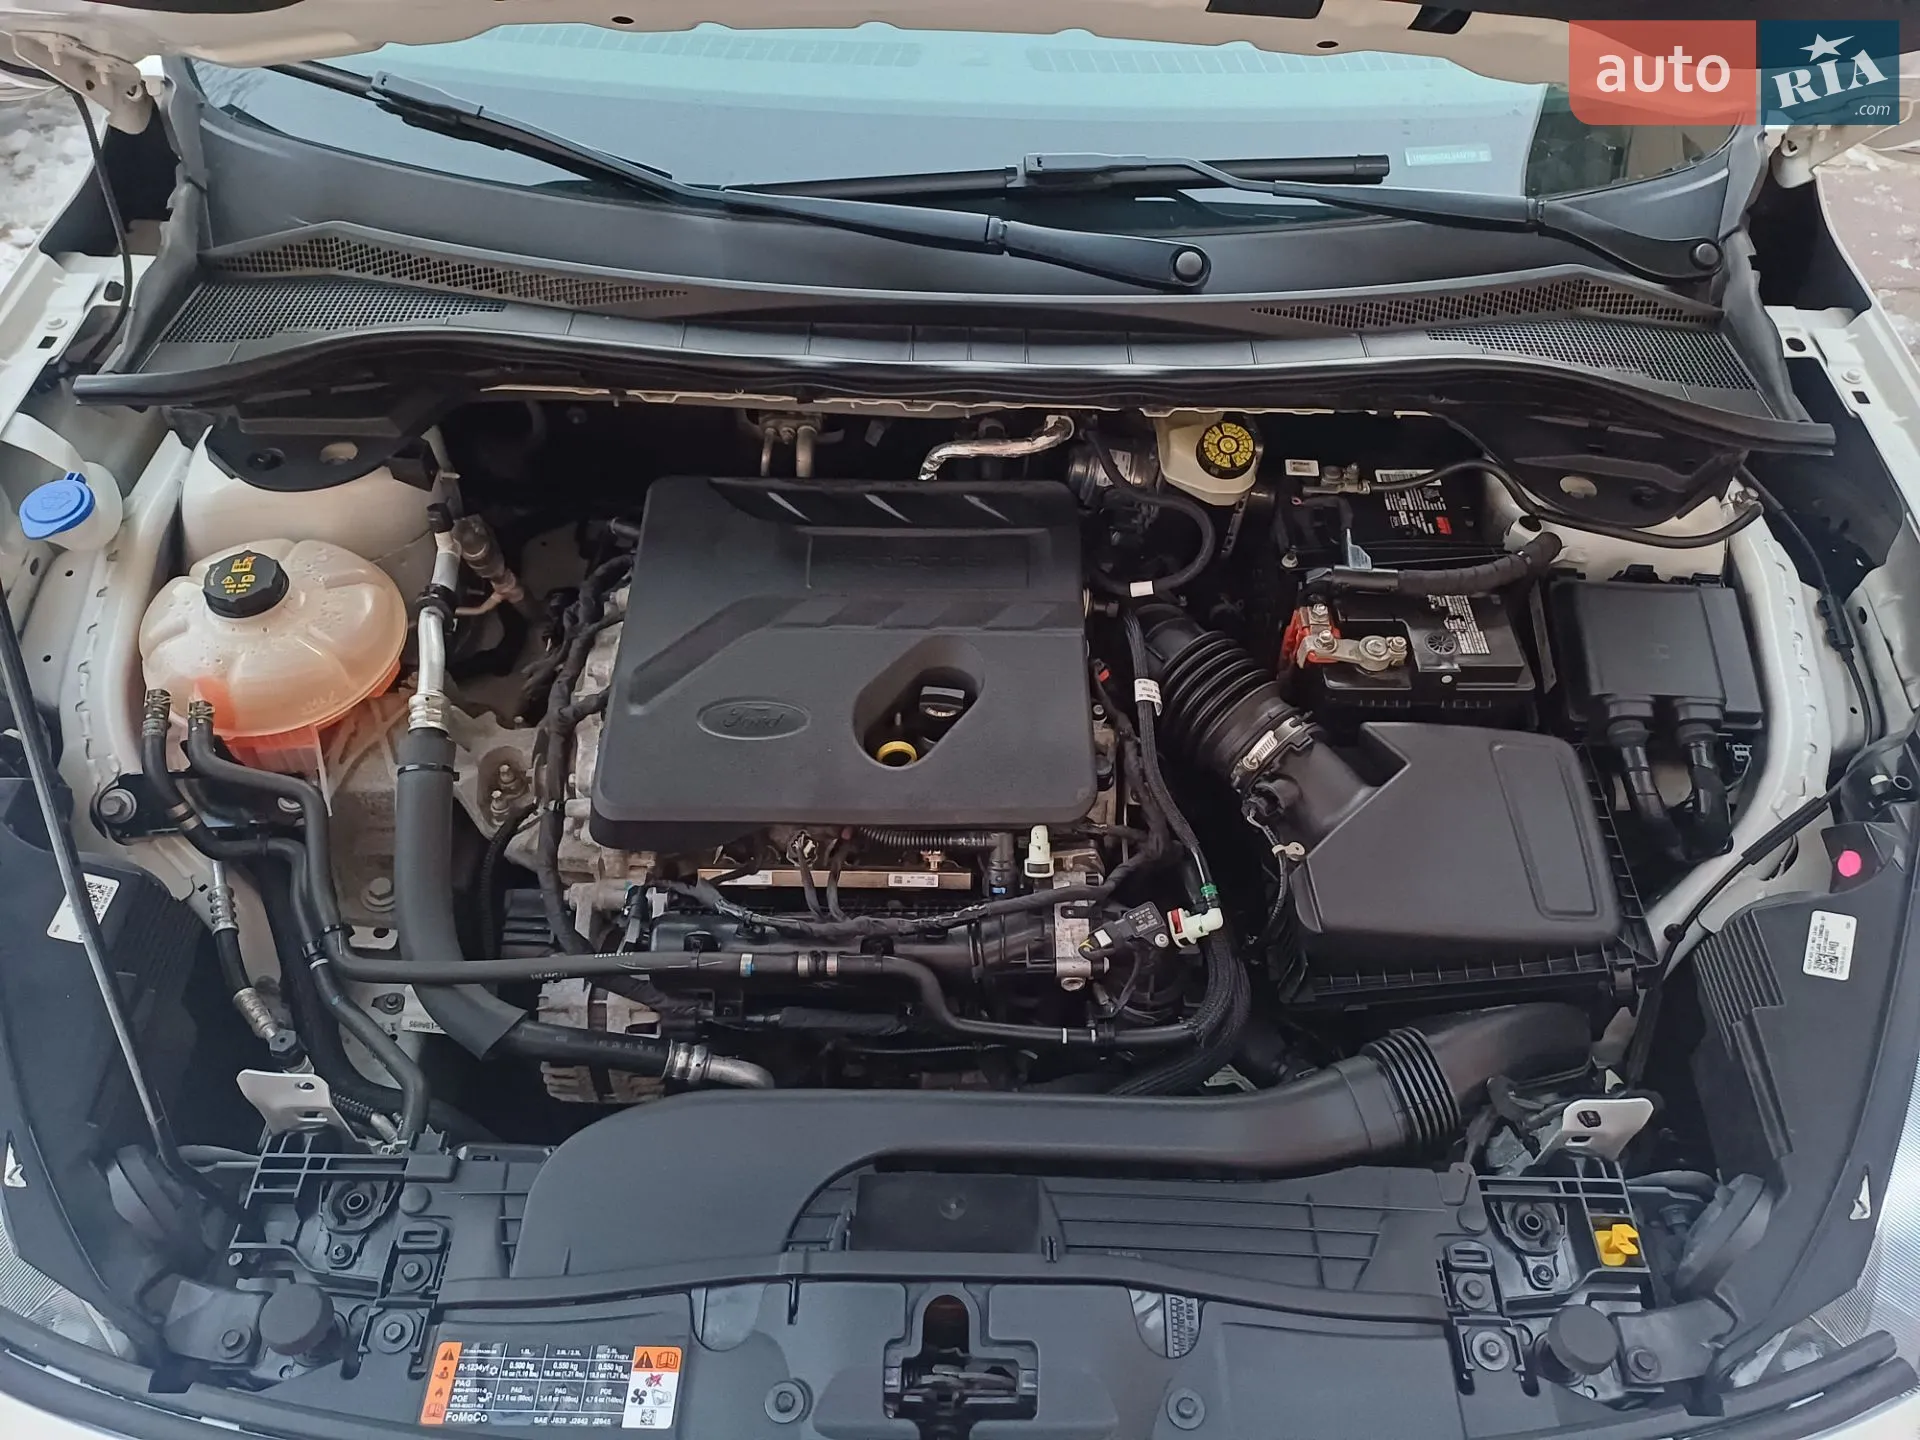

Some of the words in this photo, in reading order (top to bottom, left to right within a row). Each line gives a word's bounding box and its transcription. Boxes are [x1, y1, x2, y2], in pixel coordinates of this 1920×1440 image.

[458, 1363, 490, 1372] R-1234yf
[526, 1362, 535, 1370] kg
[570, 1362, 579, 1371] kg
[614, 1364, 624, 1372] kg
[451, 1394, 468, 1402] POE
[445, 1411, 488, 1422] FoMoCo
[534, 1416, 548, 1424] SAE
